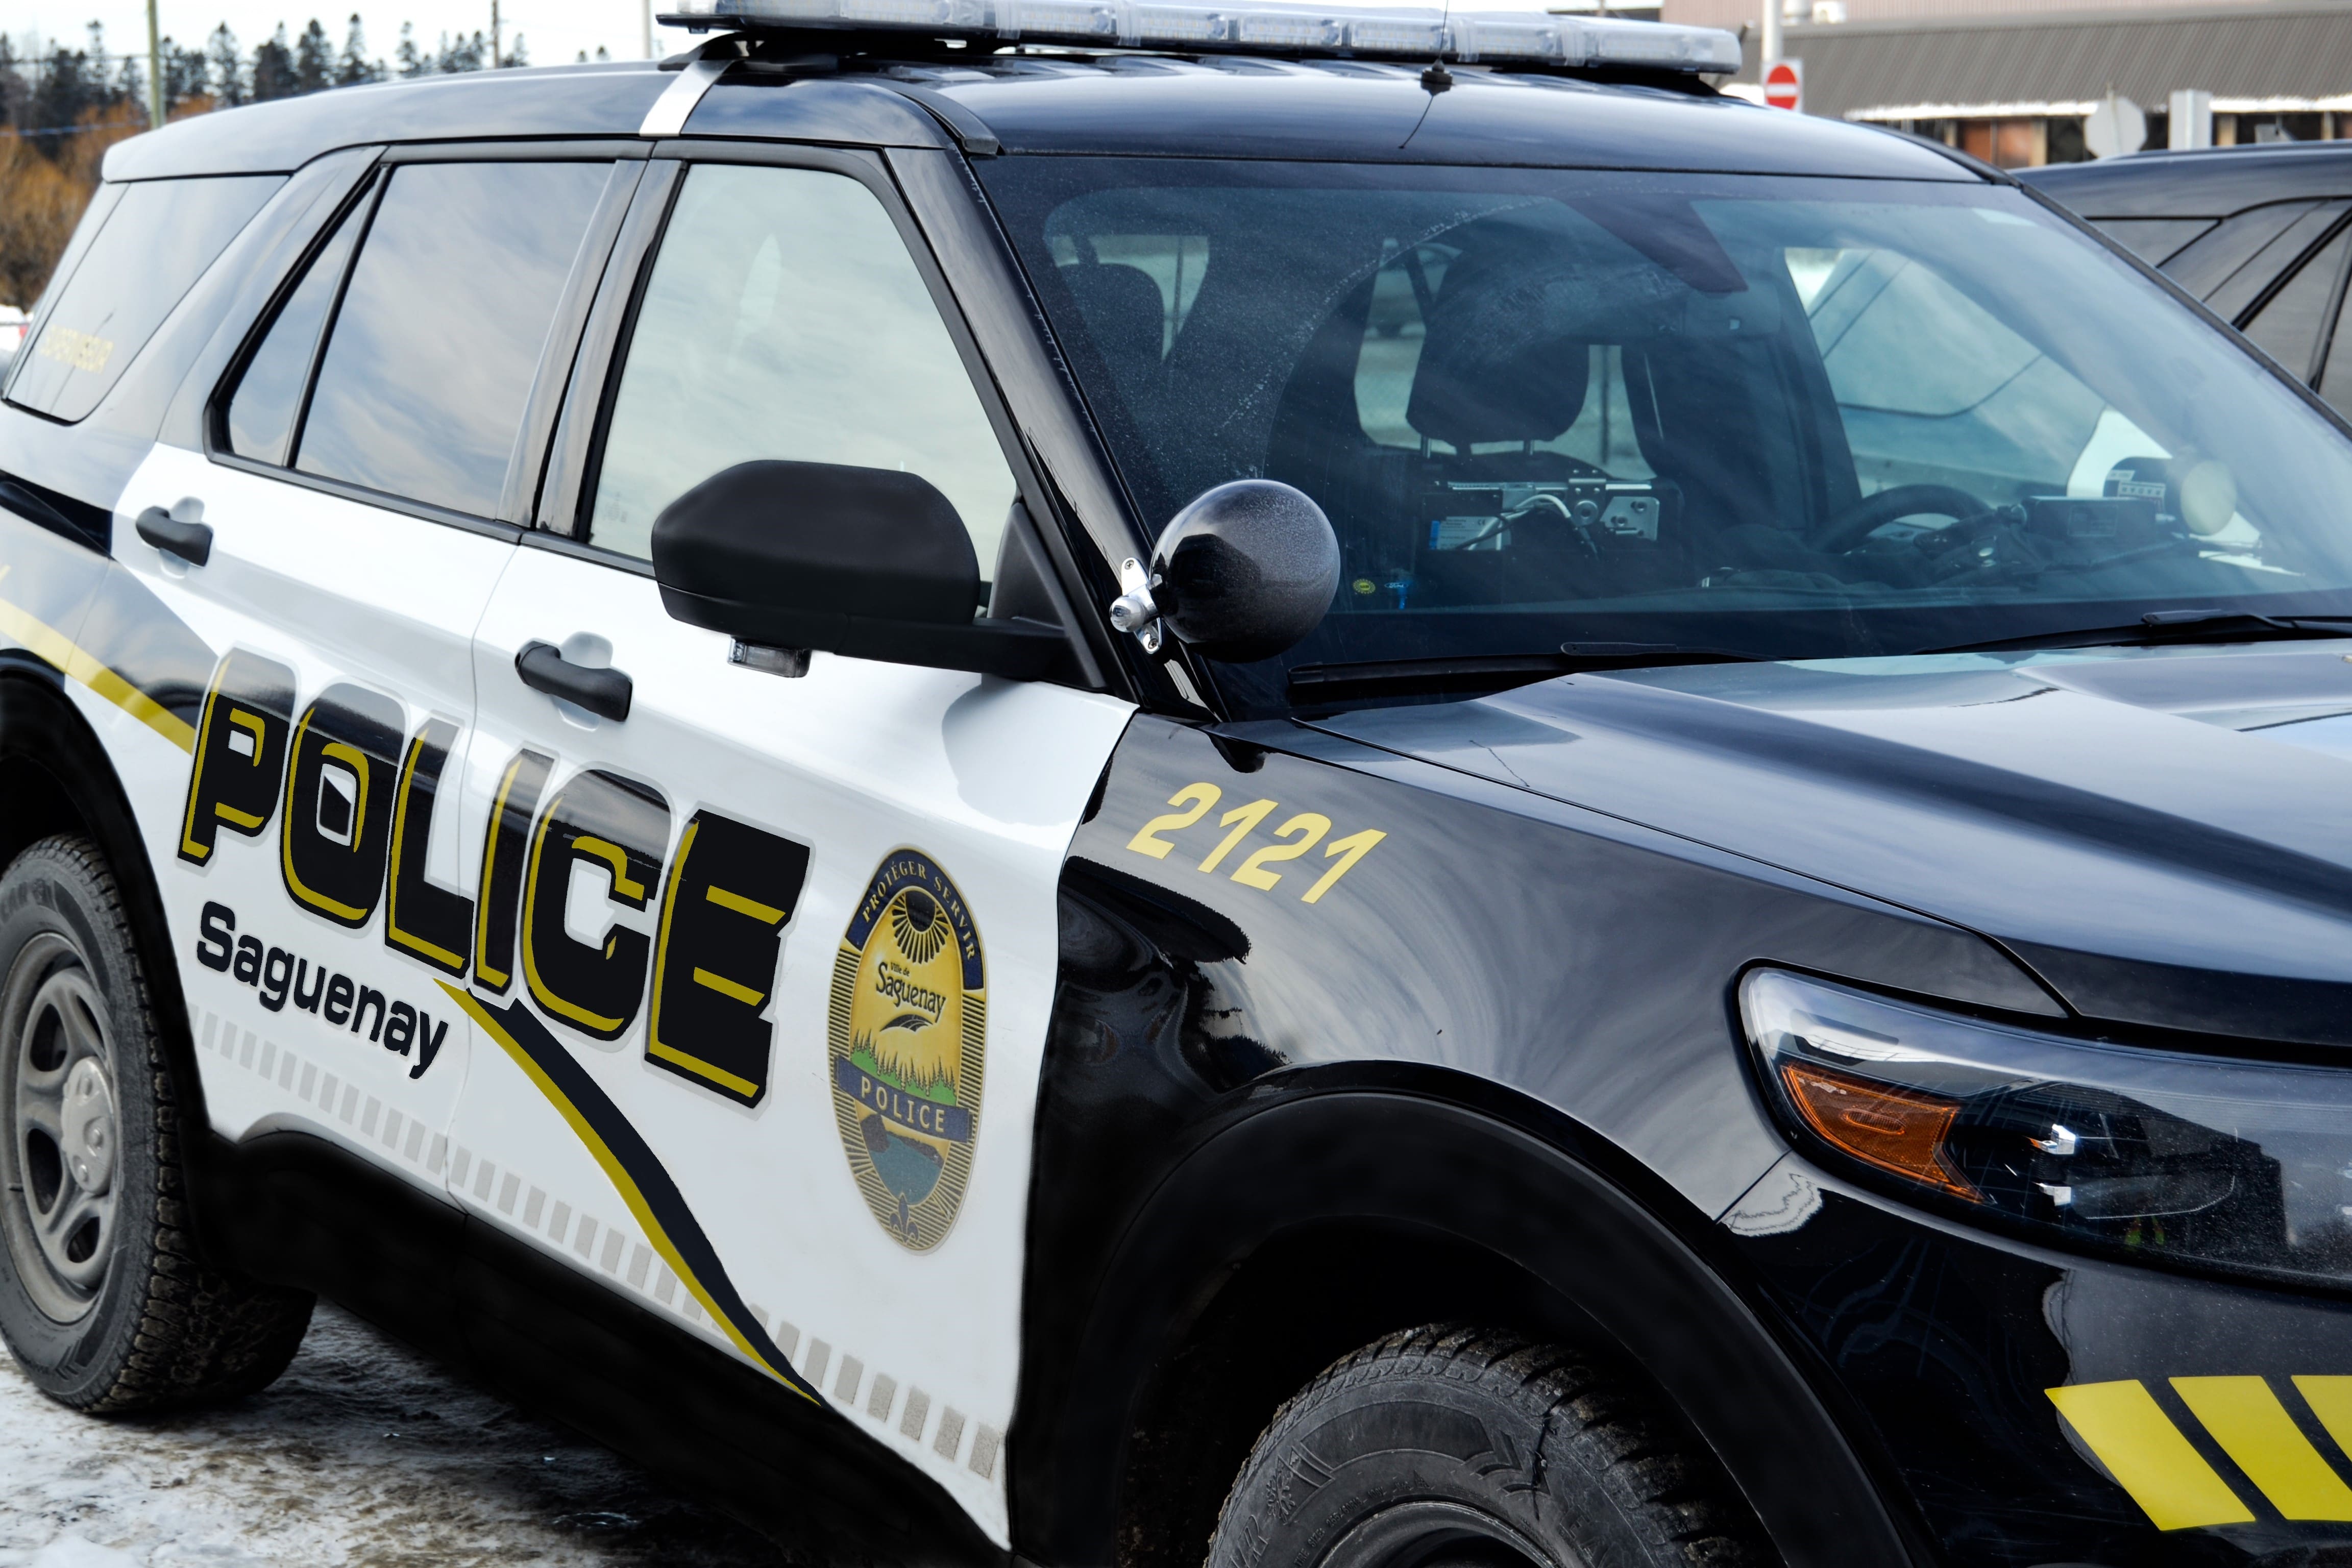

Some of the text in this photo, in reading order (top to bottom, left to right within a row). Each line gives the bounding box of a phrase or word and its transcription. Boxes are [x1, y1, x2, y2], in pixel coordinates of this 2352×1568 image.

[177, 645, 811, 1109] POLICE
[1125, 782, 1387, 904] 2121
[861, 861, 976, 961] PROTÉGER SERVIR
[196, 900, 448, 1080] Saguenay
[876, 962, 946, 1023] Saguenay
[902, 968, 910, 976] de
[861, 1075, 945, 1133] POLICE
